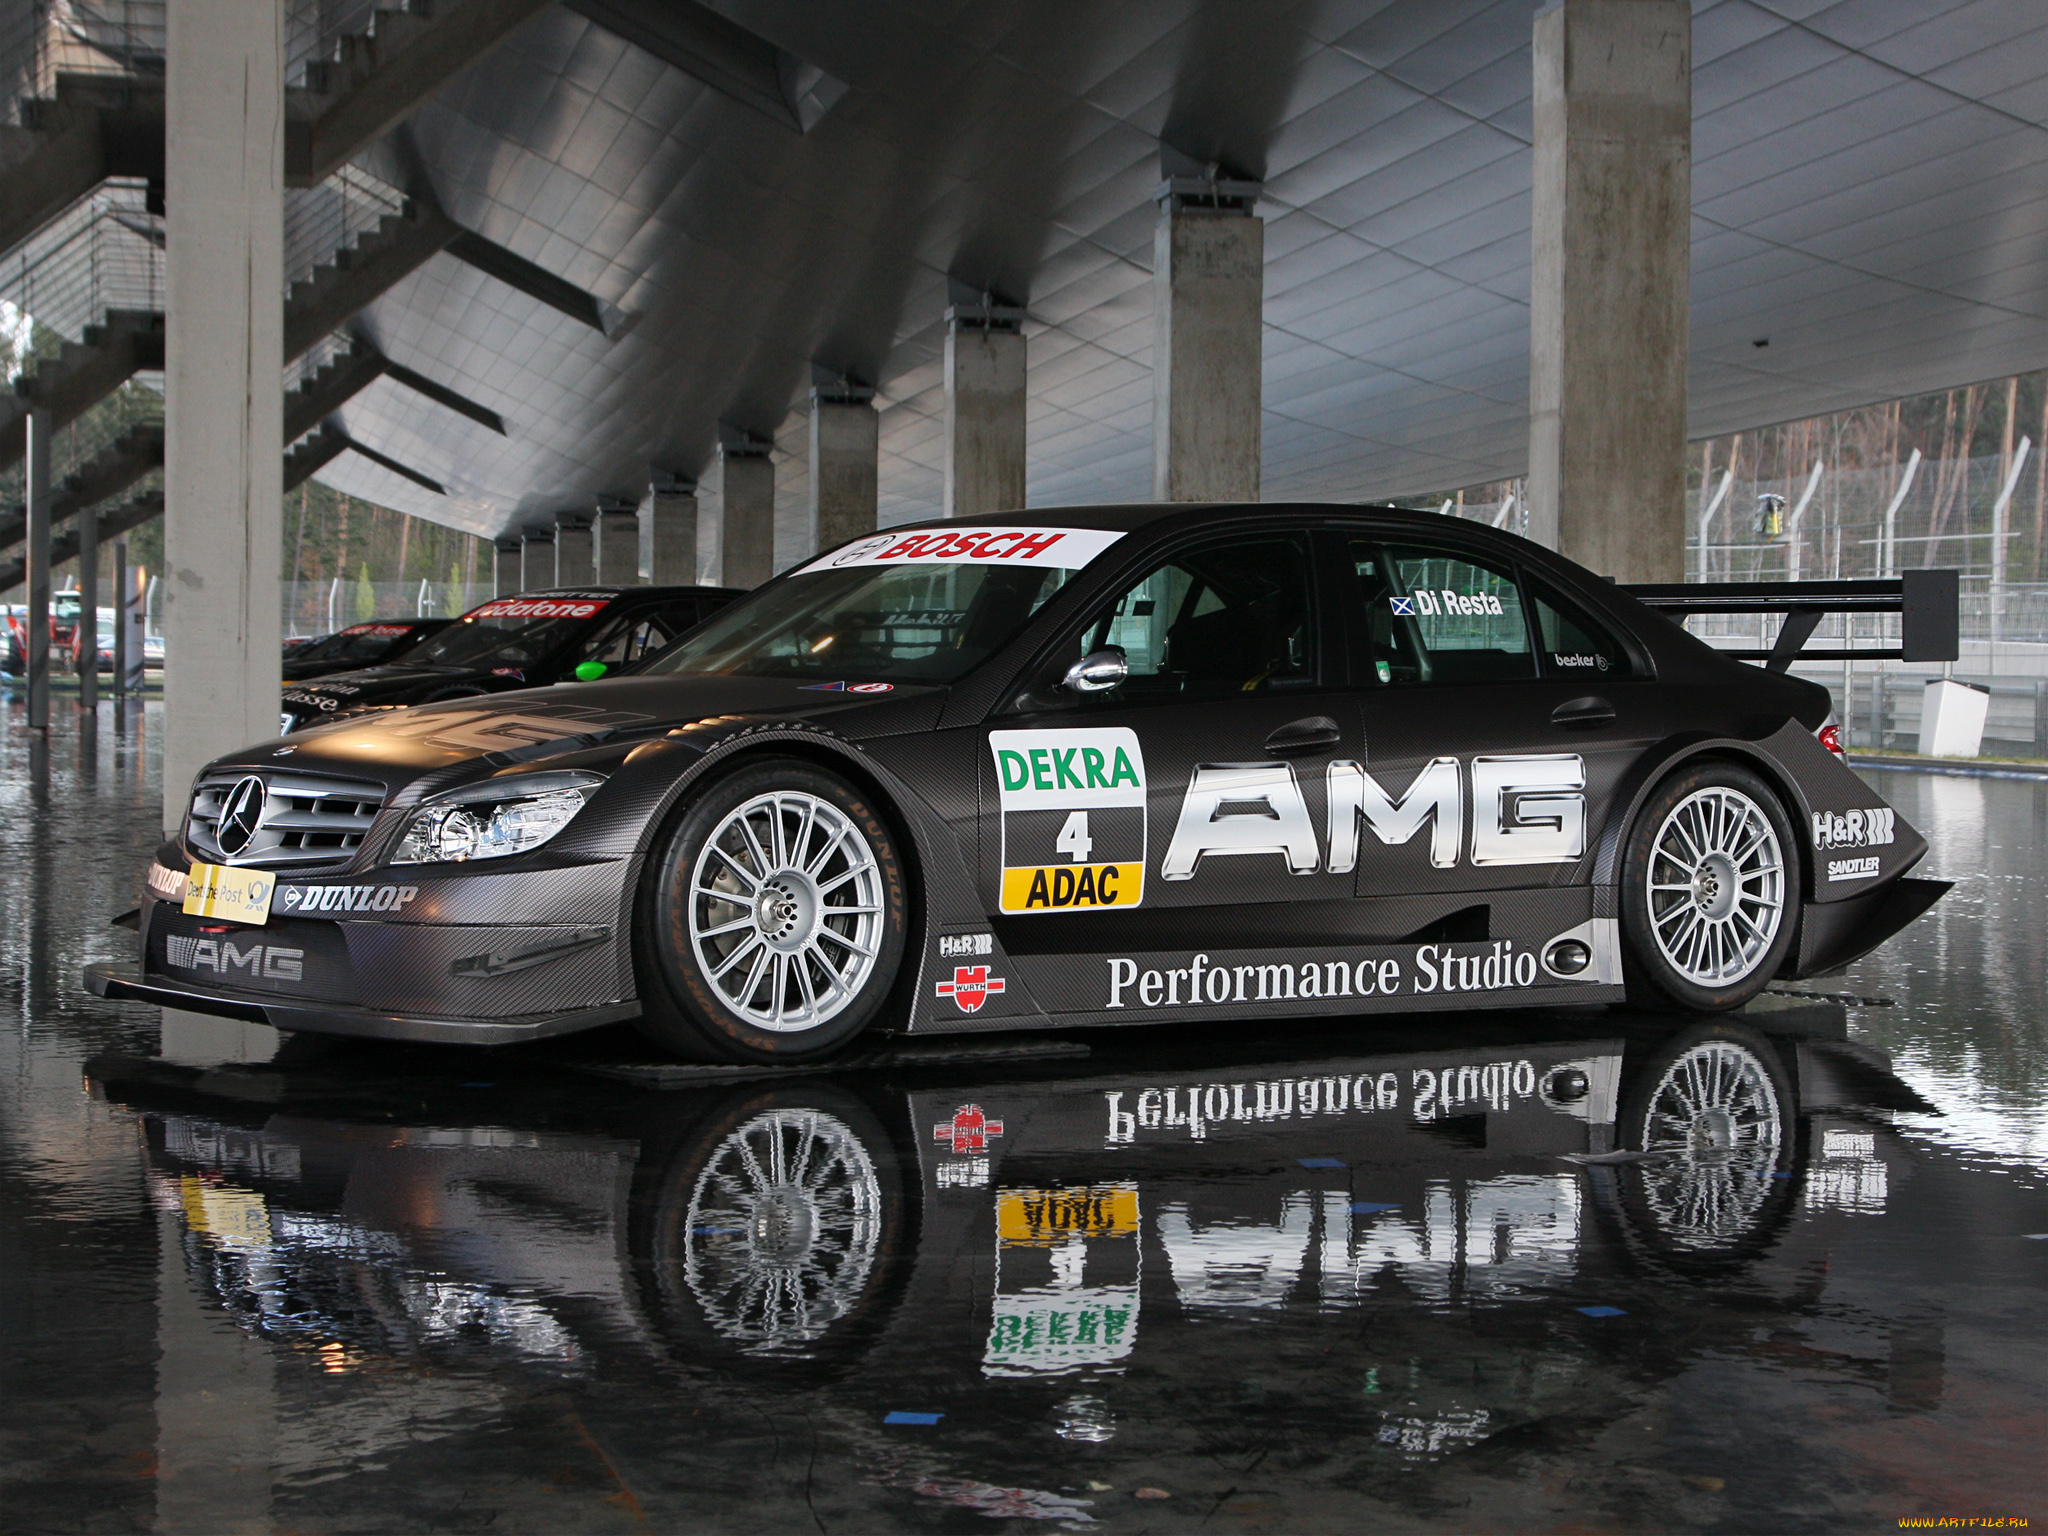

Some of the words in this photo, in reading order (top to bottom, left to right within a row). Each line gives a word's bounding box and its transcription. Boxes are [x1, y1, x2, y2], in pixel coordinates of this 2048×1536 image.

[874, 532, 1067, 559] BOSCH
[470, 600, 596, 617] vodafone
[1415, 590, 1442, 616] Di
[1442, 590, 1503, 616] Resta
[1555, 653, 1594, 667] becker
[998, 746, 1140, 791] DEKRA
[1161, 753, 1587, 881] AMG
[1812, 809, 1869, 850] H&R
[1055, 811, 1092, 862] 4
[1827, 856, 1880, 876] SANDTLER
[187, 881, 218, 900] Deutsche
[220, 885, 242, 903] Post
[298, 886, 418, 911] DUNLOP
[1025, 865, 1118, 908] ADAC
[940, 934, 975, 957] H&R
[191, 938, 304, 981] AMG
[1106, 952, 1400, 1008] Performance
[1414, 940, 1537, 994] Studio
